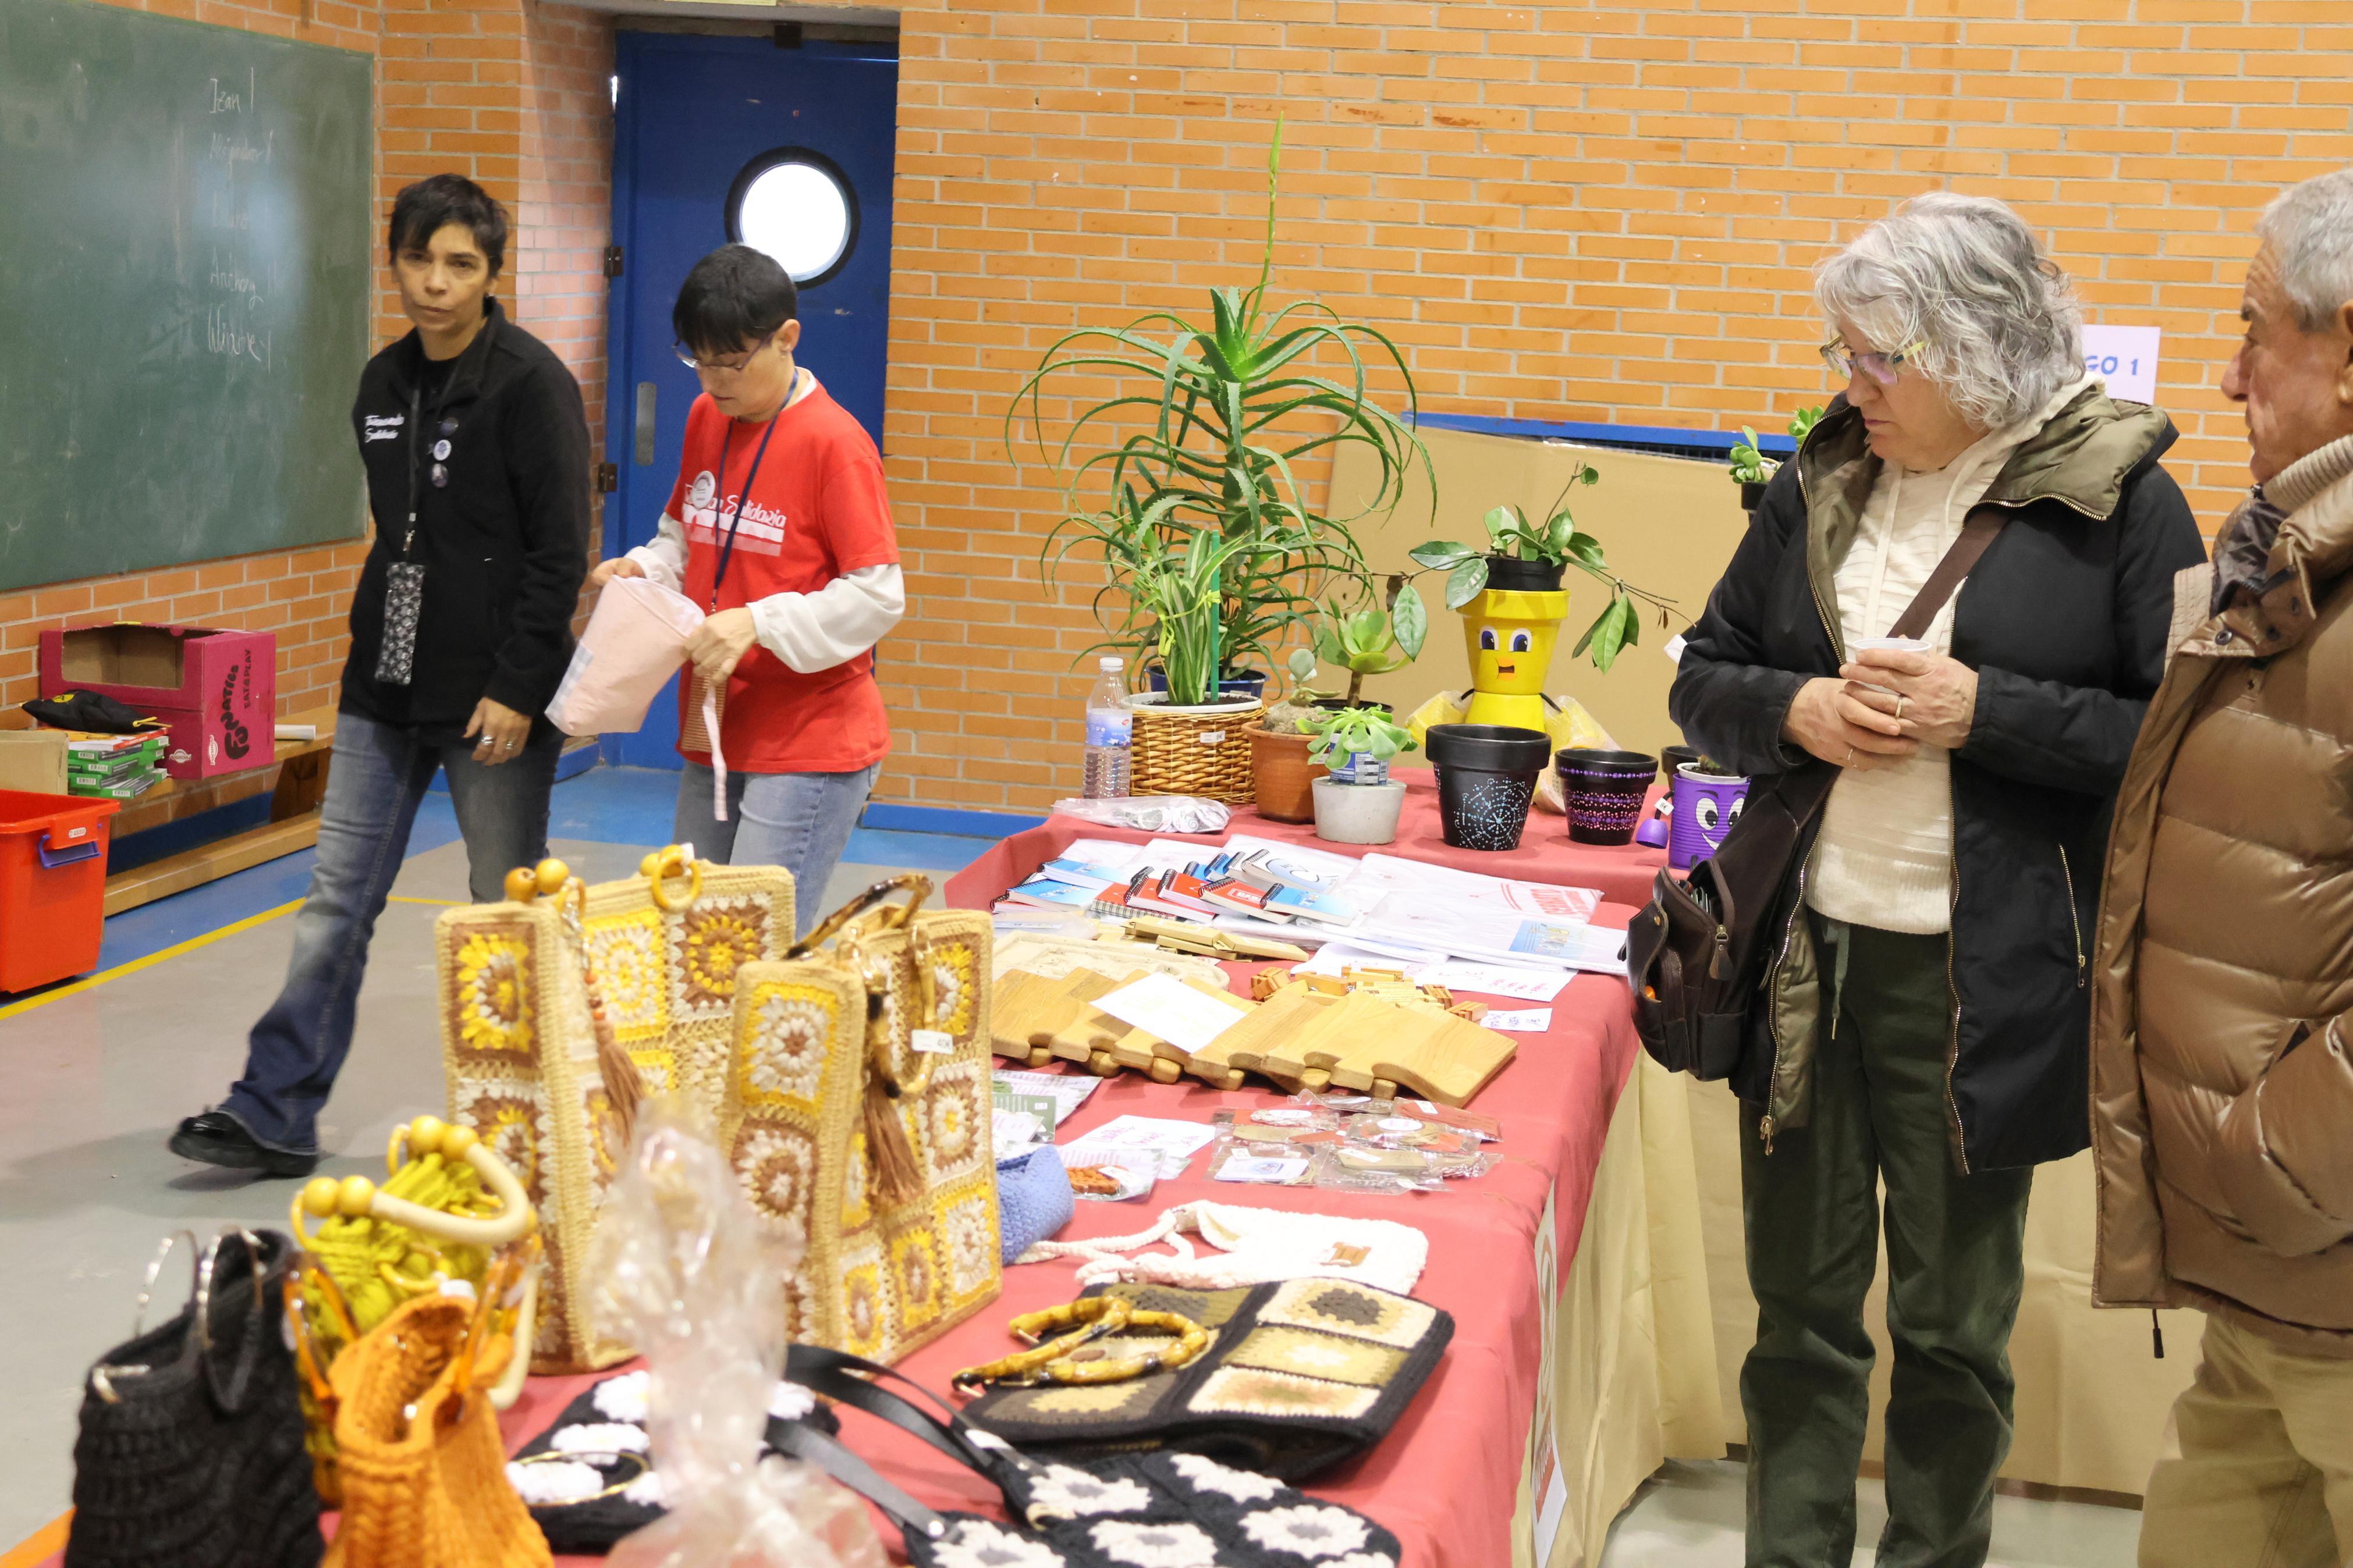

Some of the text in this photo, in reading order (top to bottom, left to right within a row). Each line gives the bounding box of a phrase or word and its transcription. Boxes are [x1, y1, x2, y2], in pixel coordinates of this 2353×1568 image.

[210, 78, 242, 114] Izan
[2131, 359, 2138, 375] 1
[1659, 802, 1669, 810] 8€
